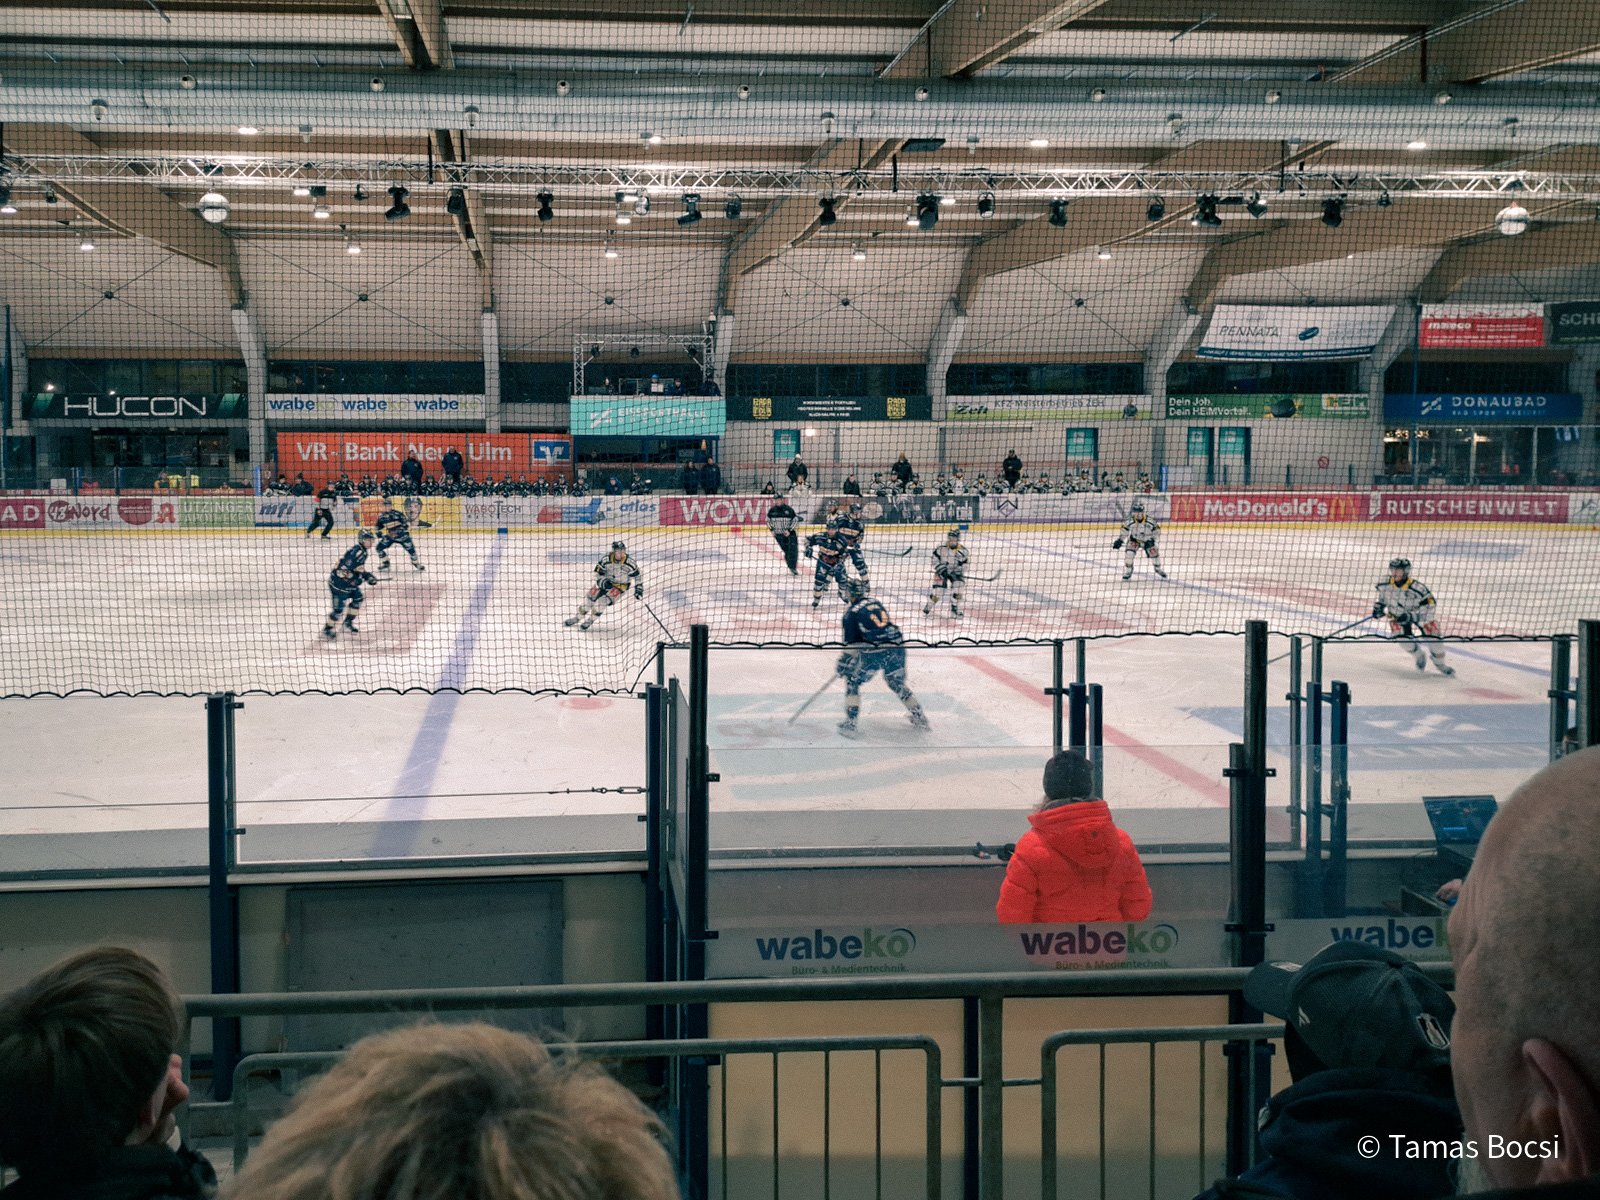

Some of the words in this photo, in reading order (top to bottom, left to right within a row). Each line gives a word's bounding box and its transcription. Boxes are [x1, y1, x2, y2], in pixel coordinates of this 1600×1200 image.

[64, 397, 206, 416] HUCON
[1169, 397, 1190, 406] Dein
[1451, 396, 1548, 407] DONAUBAD
[1169, 407, 1190, 416] Dein
[1203, 498, 1329, 517] McDonald's
[1386, 500, 1558, 516] RUTSCHENWELT
[756, 927, 915, 960] wabeko
[1020, 924, 1177, 956] wabeko
